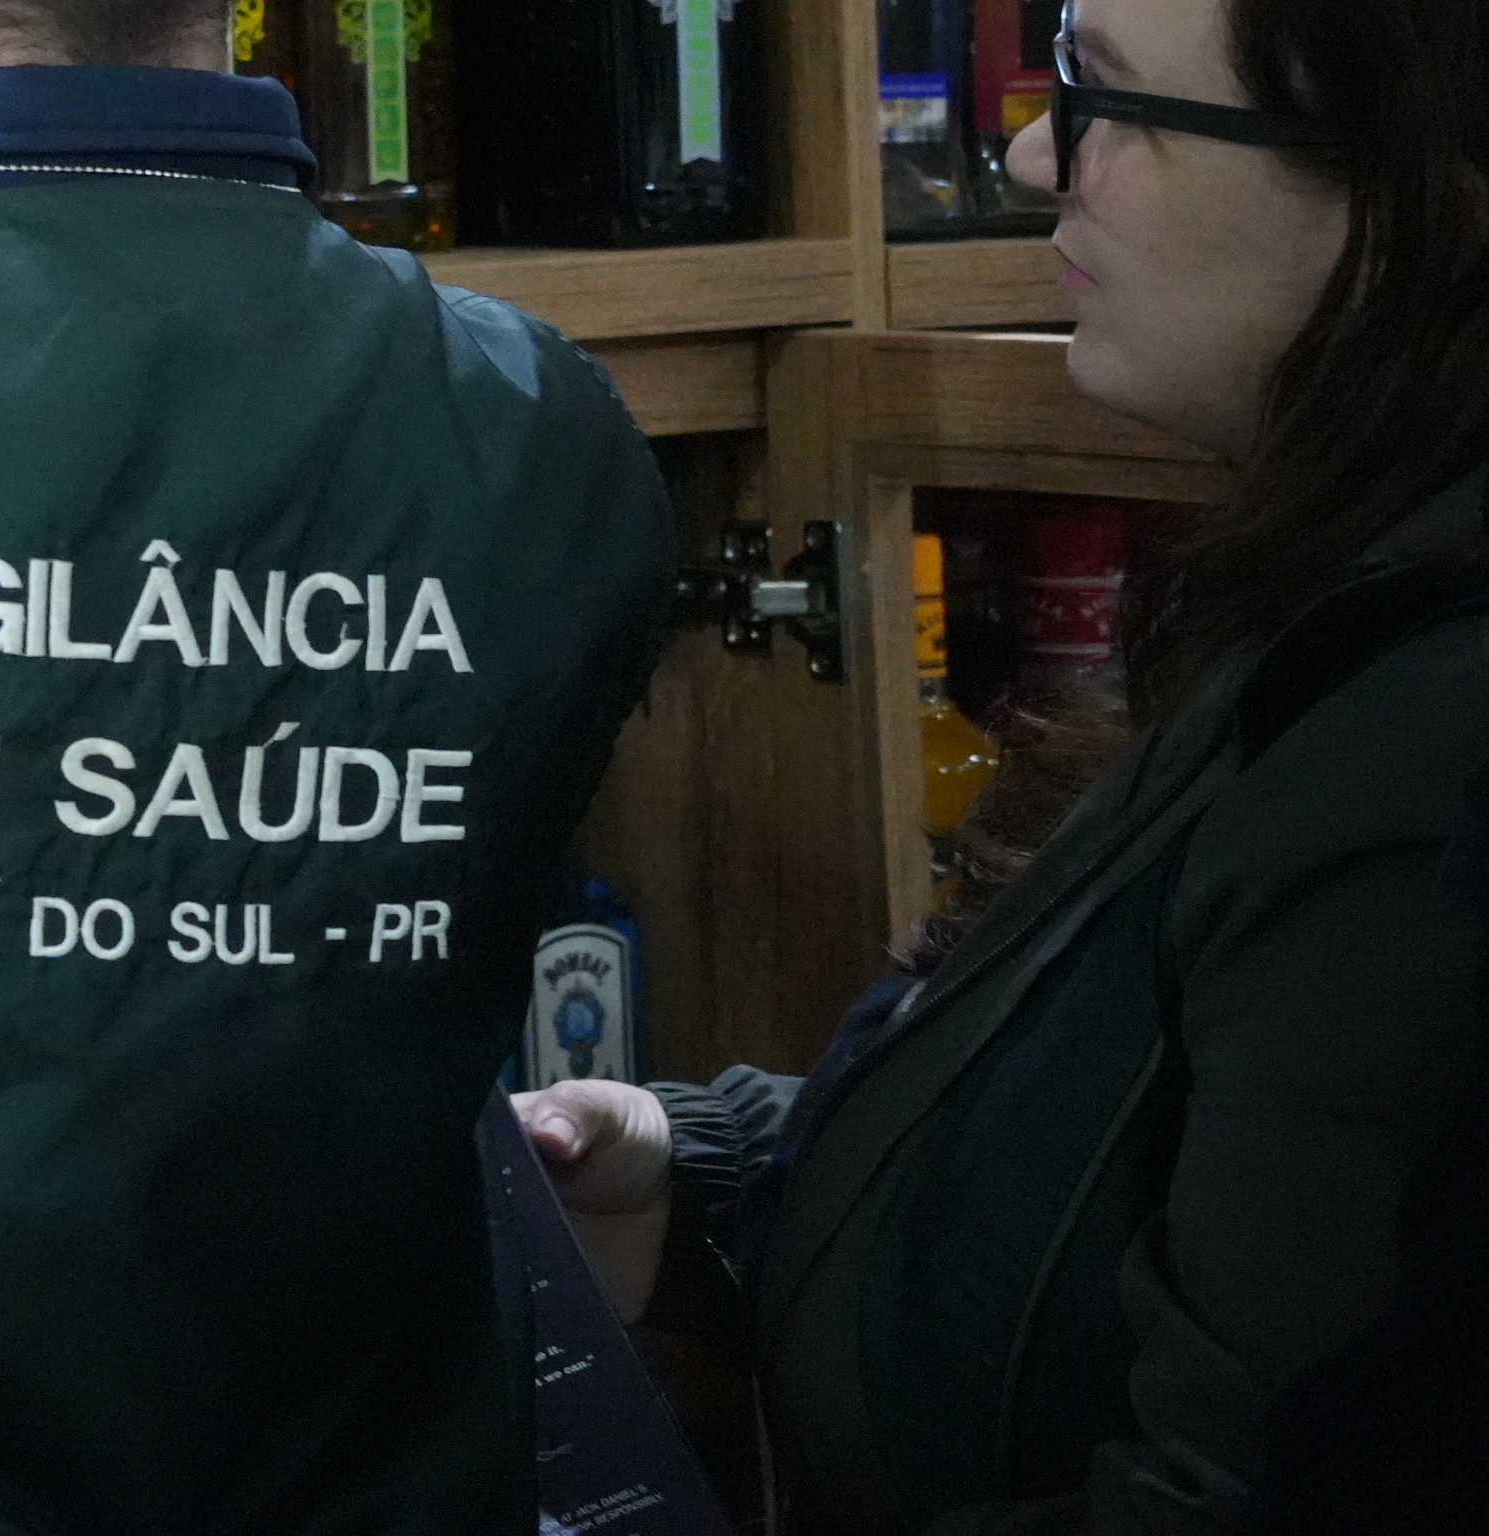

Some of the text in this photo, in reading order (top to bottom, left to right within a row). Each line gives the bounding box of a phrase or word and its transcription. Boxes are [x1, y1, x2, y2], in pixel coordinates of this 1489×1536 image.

[54, 721, 474, 843] SAÚDE
[29, 896, 135, 961] DO
[167, 901, 295, 965] SUL
[369, 900, 452, 962] PR
